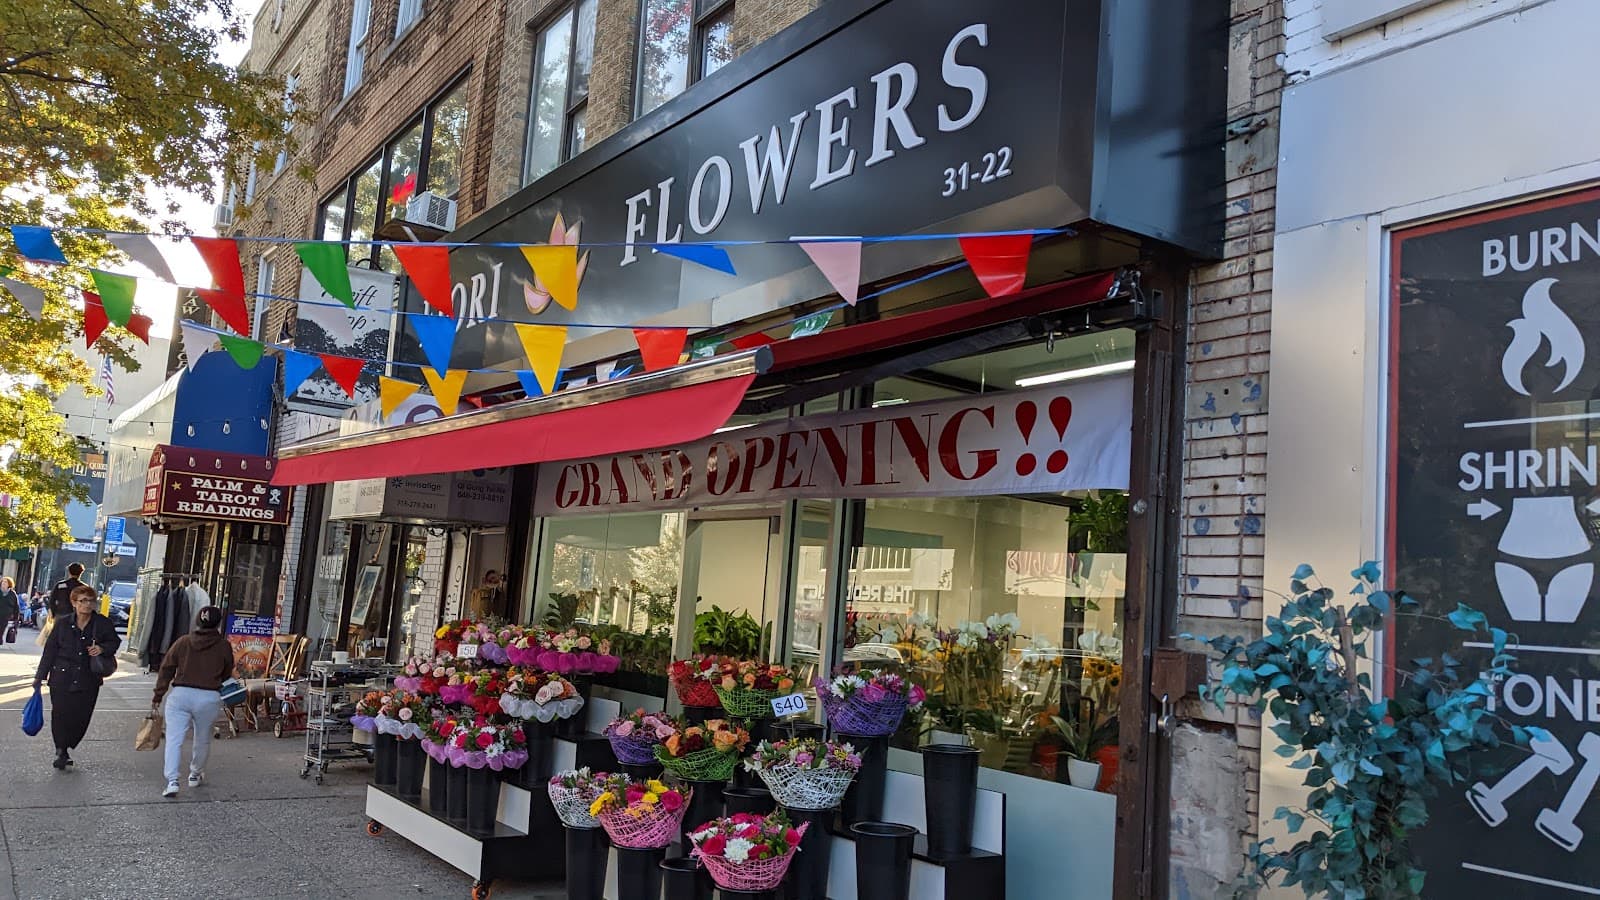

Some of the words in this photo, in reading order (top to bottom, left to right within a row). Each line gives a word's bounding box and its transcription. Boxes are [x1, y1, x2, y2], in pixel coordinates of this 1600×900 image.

[419, 262, 504, 348] ORI
[620, 23, 989, 267] FLOWERS
[942, 146, 1013, 197] 31-22
[1482, 219, 1600, 277] BURN
[183, 290, 200, 315] LAW
[191, 478, 243, 492] PALM
[252, 484, 266, 495] &
[555, 449, 693, 509] GRAND
[1458, 445, 1597, 491] SHRIN
[177, 501, 275, 519] READINGS
[196, 490, 259, 506] TAROT
[775, 695, 804, 713] $40
[1479, 672, 1600, 722] TONE
